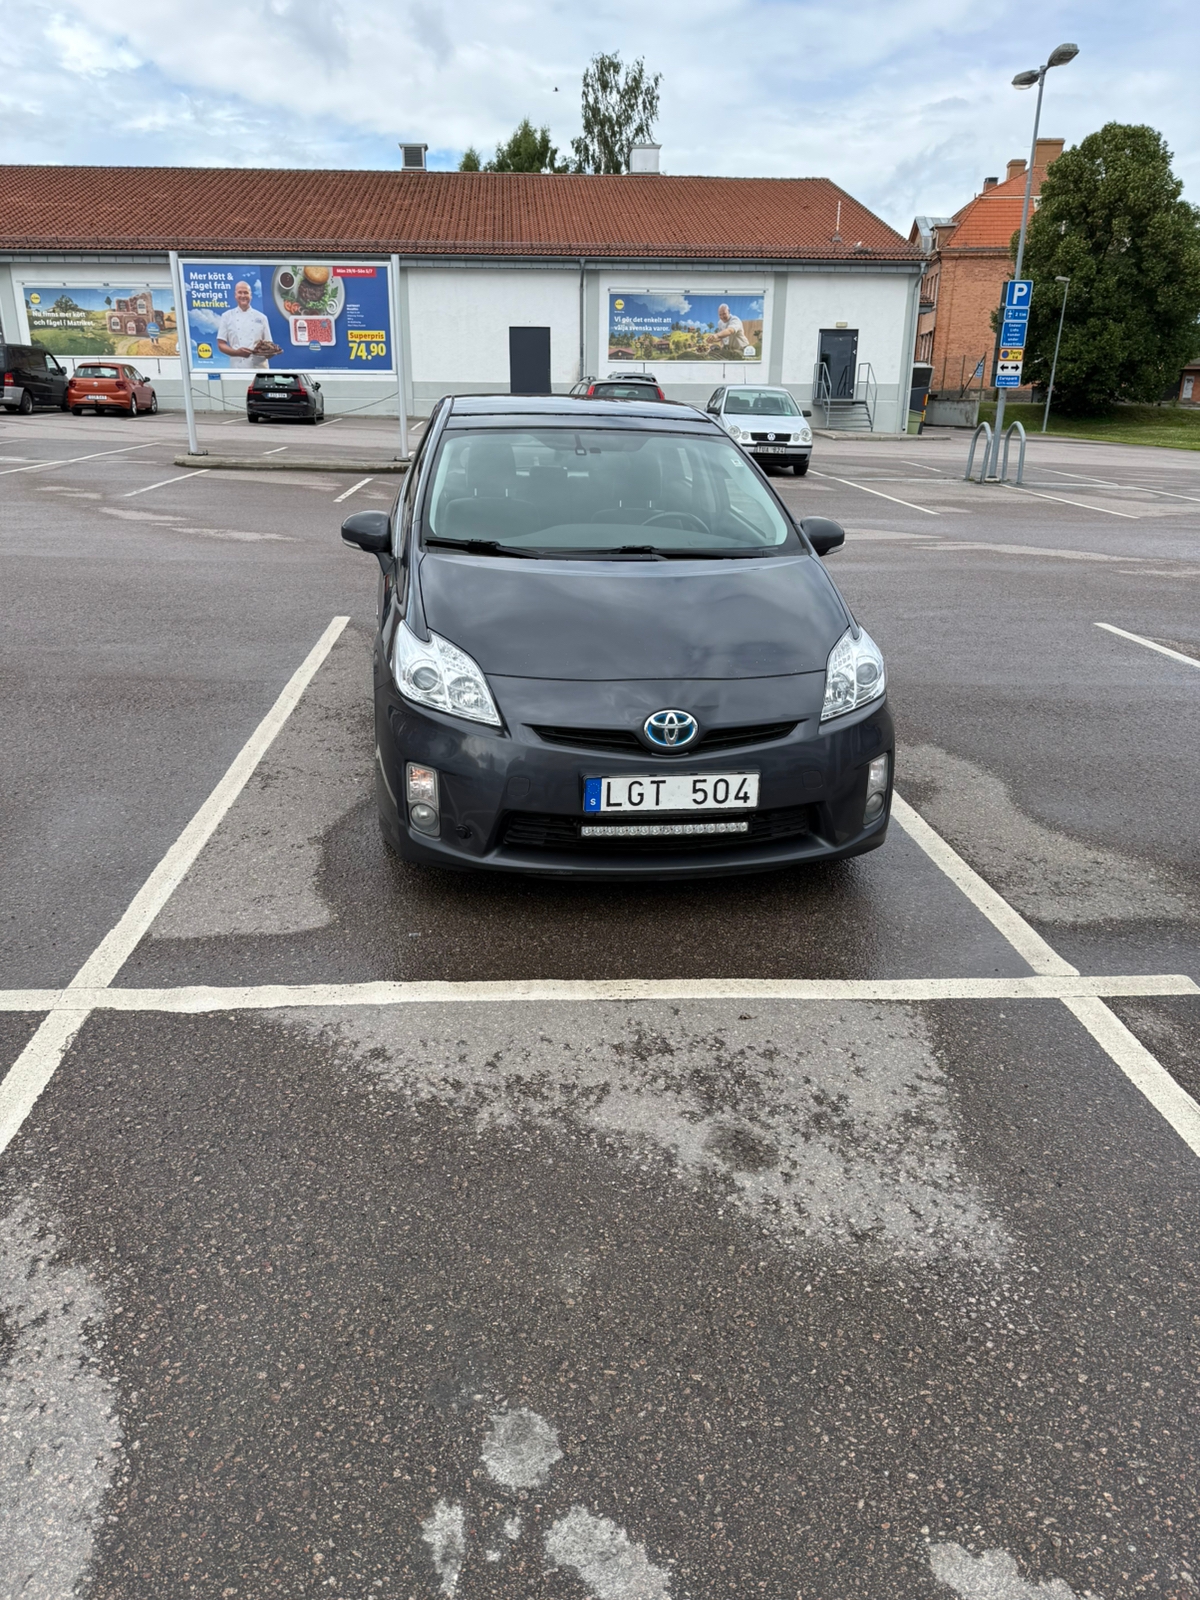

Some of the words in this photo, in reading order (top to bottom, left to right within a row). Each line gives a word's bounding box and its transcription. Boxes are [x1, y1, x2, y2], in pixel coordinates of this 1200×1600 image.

[190, 271, 207, 281] Mer
[208, 271, 226, 281] kött
[226, 272, 234, 281] &
[190, 281, 213, 291] fågel
[214, 281, 232, 290] från
[192, 290, 223, 300] Sverige
[224, 290, 228, 299] i
[1012, 283, 1028, 305] P
[192, 300, 231, 308] Matriket.
[349, 332, 384, 341] Superpris
[348, 342, 386, 360] 74.90
[606, 780, 666, 808] LGT
[692, 778, 750, 804] 504
